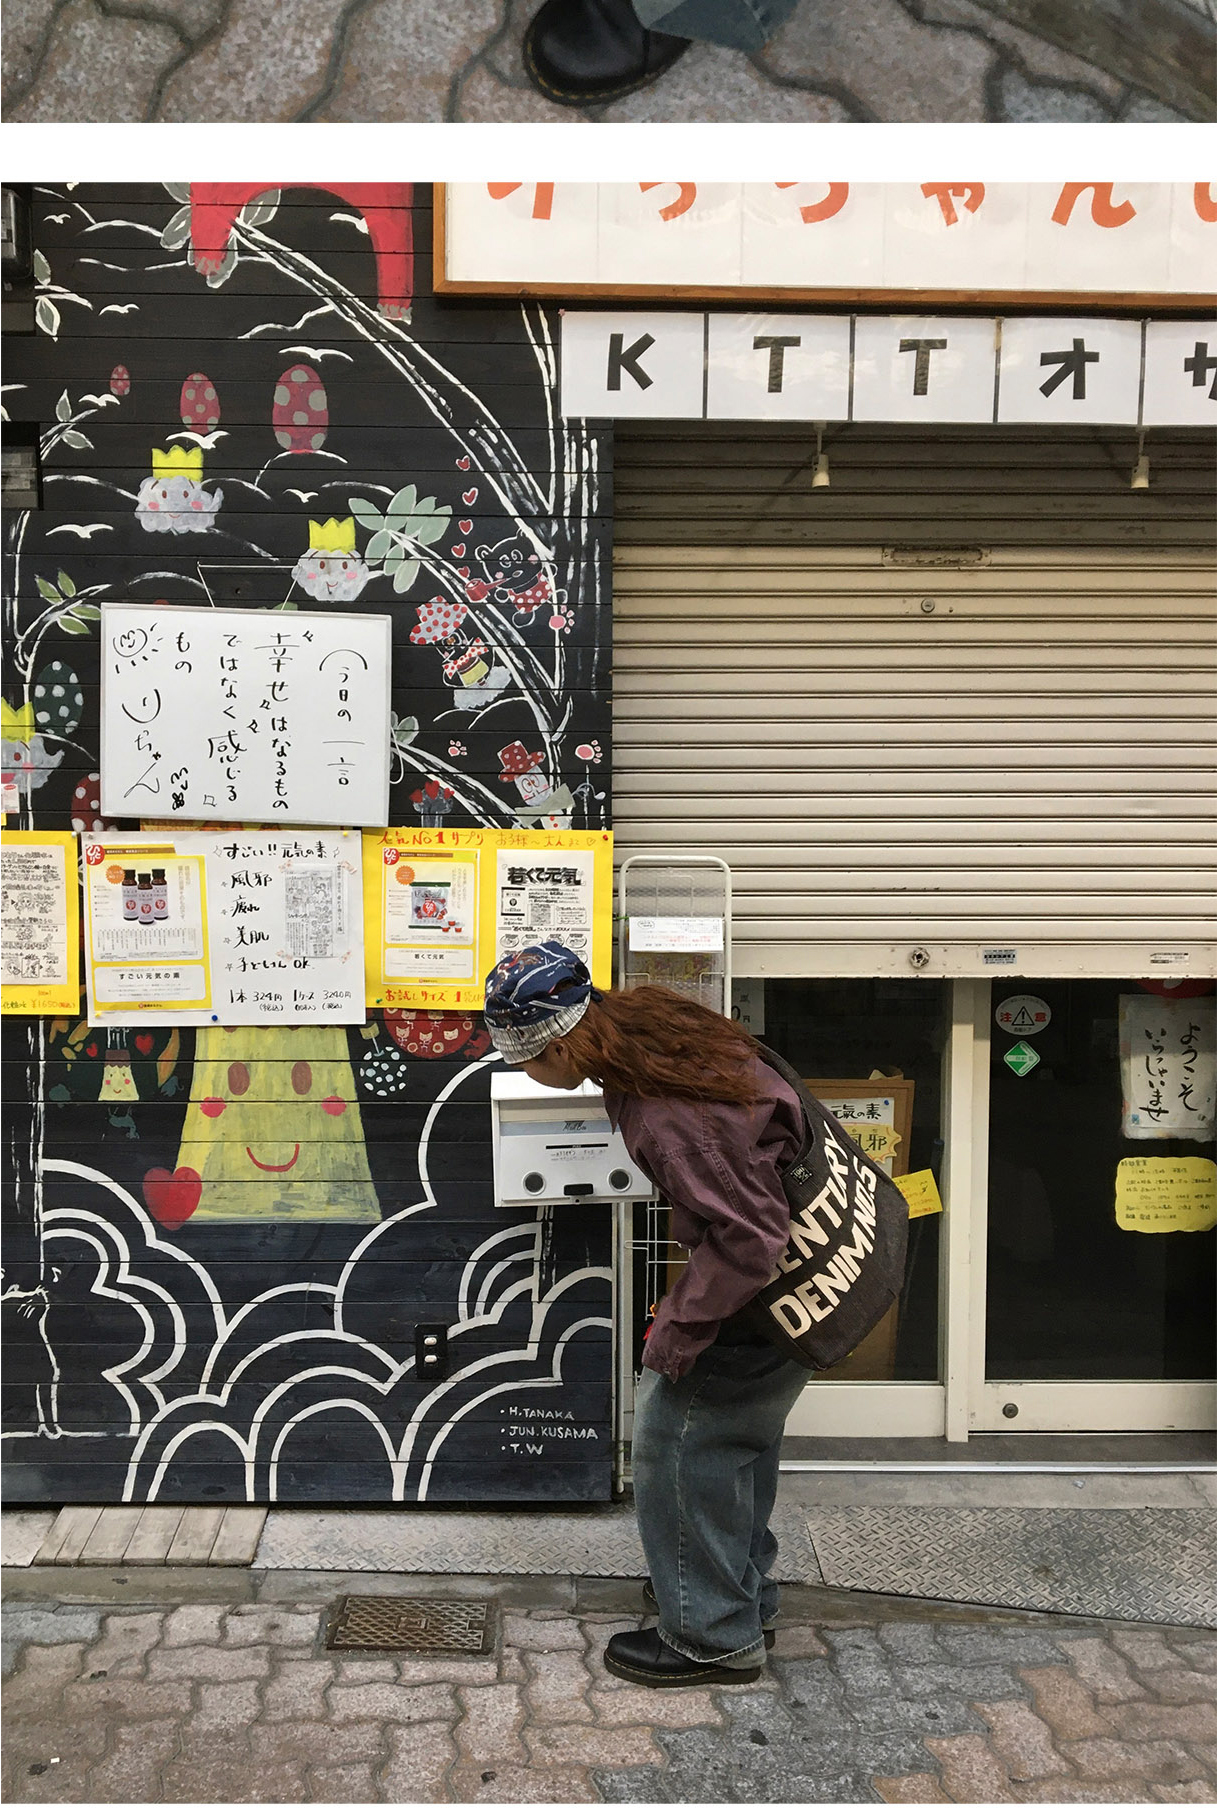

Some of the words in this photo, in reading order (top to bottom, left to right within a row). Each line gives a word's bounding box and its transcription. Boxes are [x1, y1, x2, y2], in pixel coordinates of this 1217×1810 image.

[174, 631, 192, 673] もの
[230, 869, 272, 889] 風邪
[233, 925, 270, 949] 美肌
[1178, 1022, 1201, 1112] ようこそ
[768, 1223, 874, 1339] DENIM
[509, 1406, 575, 1420] H.TANAKA
[509, 1425, 599, 1439] JUN.KUSAMA
